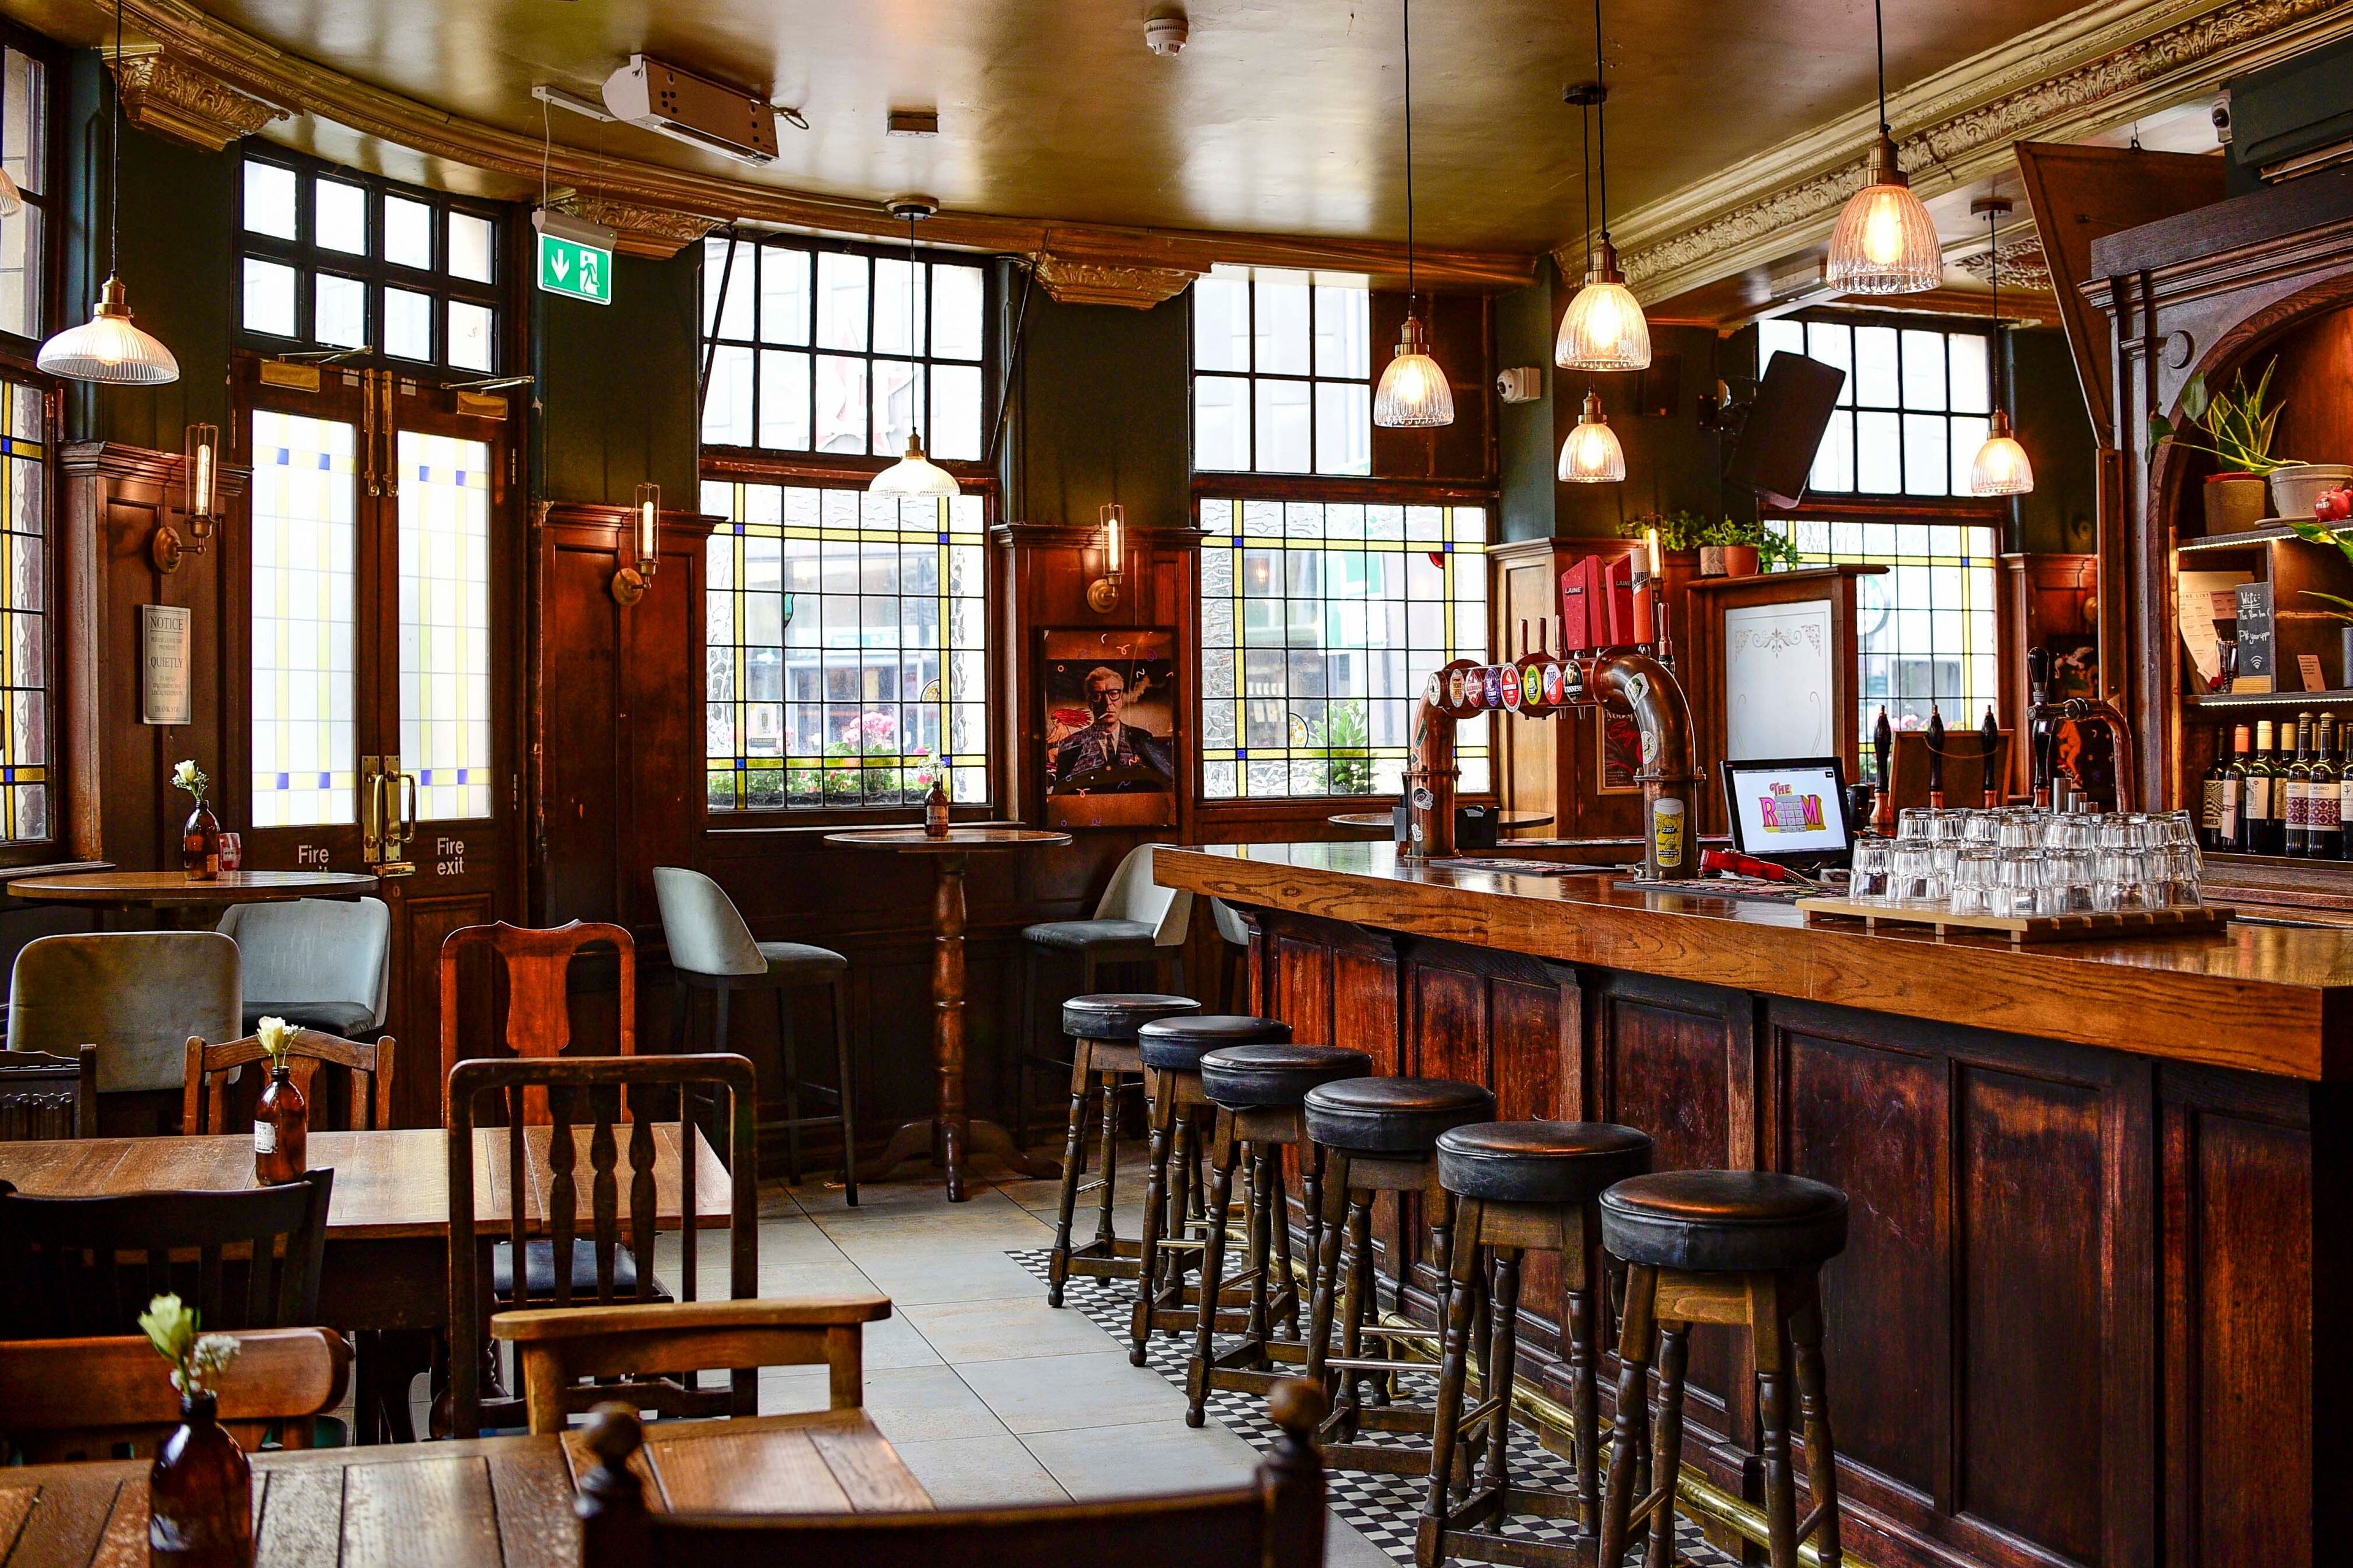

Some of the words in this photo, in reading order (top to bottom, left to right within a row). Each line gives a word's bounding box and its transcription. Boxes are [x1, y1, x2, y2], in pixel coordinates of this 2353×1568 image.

[150, 616, 184, 630] NOTICE
[2237, 609, 2248, 620] The
[150, 657, 183, 668] QUIETLY
[1759, 794, 1822, 828] RM
[298, 845, 329, 863] Fire
[437, 837, 465, 855] Fire
[437, 857, 464, 876] exit
